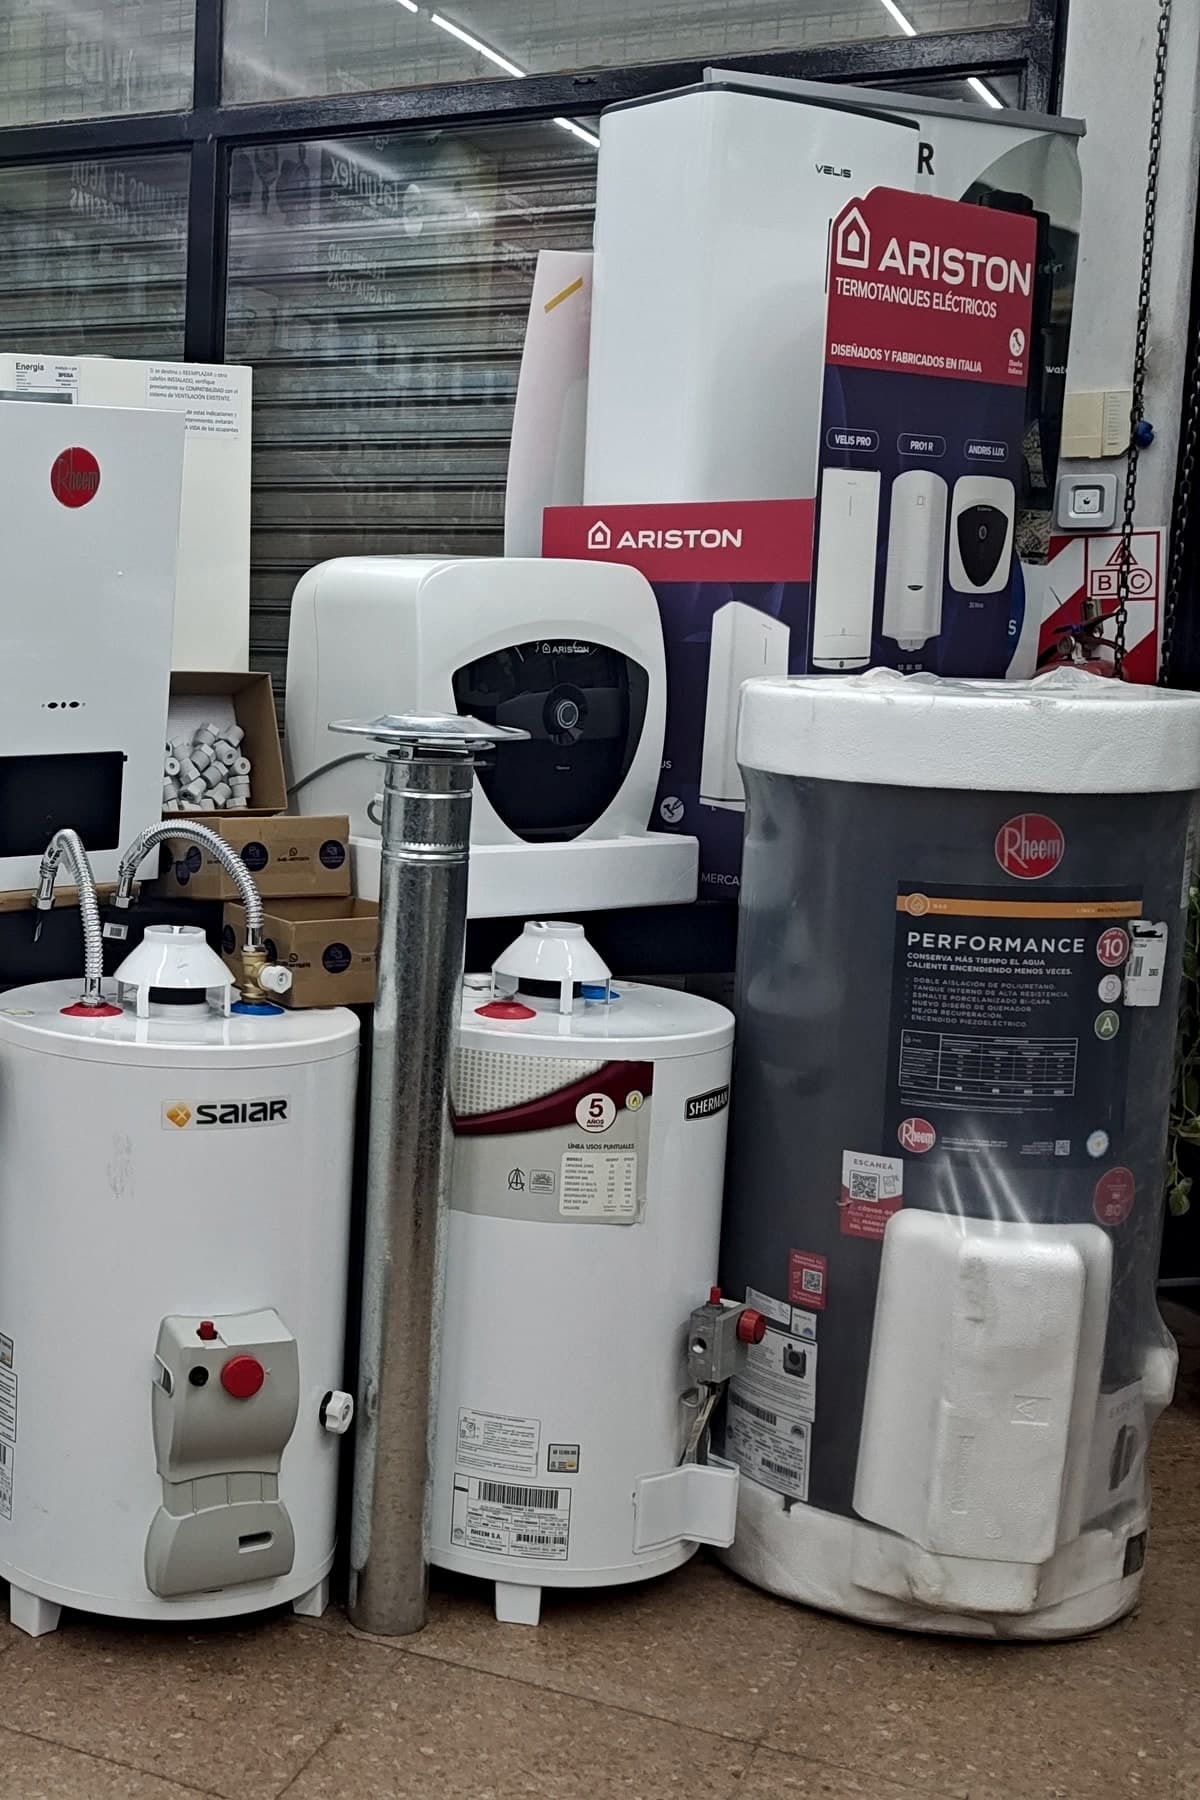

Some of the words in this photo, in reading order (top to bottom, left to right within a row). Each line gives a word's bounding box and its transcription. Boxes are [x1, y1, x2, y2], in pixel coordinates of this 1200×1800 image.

[815, 163, 852, 178] VELIS
[878, 237, 1031, 296] ARISTON
[836, 277, 930, 308] TERMOTANQUES
[932, 291, 997, 319] ELÉCTRICOS
[831, 343, 882, 361] DISEÑADOS
[884, 350, 891, 361] Y
[892, 351, 944, 368] FABRICADOS
[945, 357, 957, 369] EN
[958, 359, 982, 373] ITALIA
[834, 434, 855, 446] VELIS
[856, 435, 872, 447] PRO
[968, 445, 991, 455] ANDRIS
[57, 448, 98, 498] Rheem
[617, 529, 742, 549] ARISTON
[1099, 575, 1112, 590] B
[1131, 574, 1145, 589] C
[1004, 815, 1061, 869] Rheem
[907, 931, 1085, 954] PERFORMANCE
[1102, 938, 1123, 958] 10
[906, 961, 948, 971] CALIENTE
[950, 964, 1012, 974] ENCENDIENDO
[1014, 967, 1043, 975] MENOS
[1046, 968, 1073, 976] VECES.
[907, 952, 952, 963] CONSERVA
[954, 956, 973, 964] MÁS
[975, 957, 1008, 966] TIEMPO
[1009, 958, 1020, 966] EL
[1102, 1019, 1113, 1033] A
[589, 1098, 604, 1118] 5
[688, 1088, 728, 1116] SHERMAN
[902, 1120, 934, 1147] Rheem
